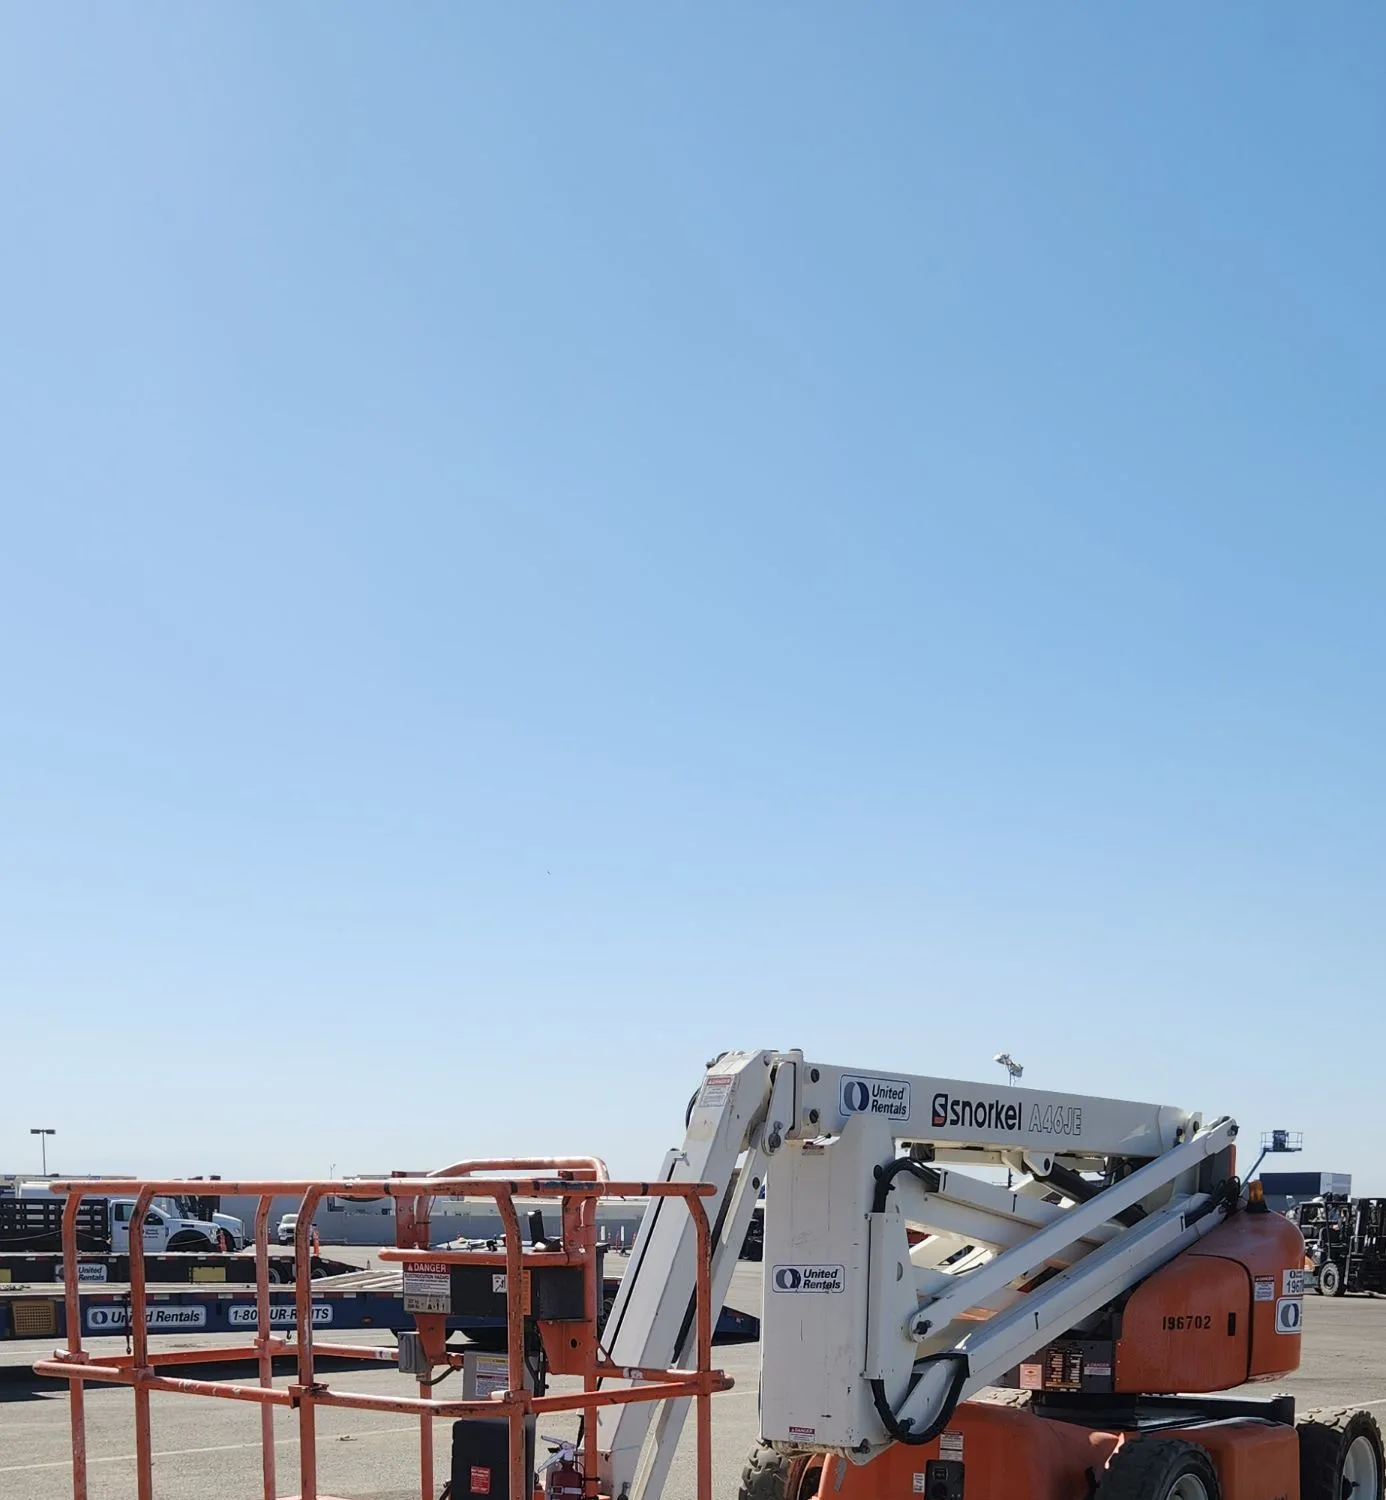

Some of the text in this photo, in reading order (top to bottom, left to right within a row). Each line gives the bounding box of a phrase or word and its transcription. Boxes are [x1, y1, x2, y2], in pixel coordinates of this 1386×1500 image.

[872, 1083, 904, 1100] United
[871, 1099, 906, 1115] Rentals
[950, 1099, 1082, 1136] snorkel A46JE
[413, 1263, 447, 1273] DANGER
[803, 1268, 838, 1279] United
[803, 1279, 841, 1289] Rentals
[155, 1309, 200, 1323] Rentals
[1162, 1315, 1212, 1331] 196702
